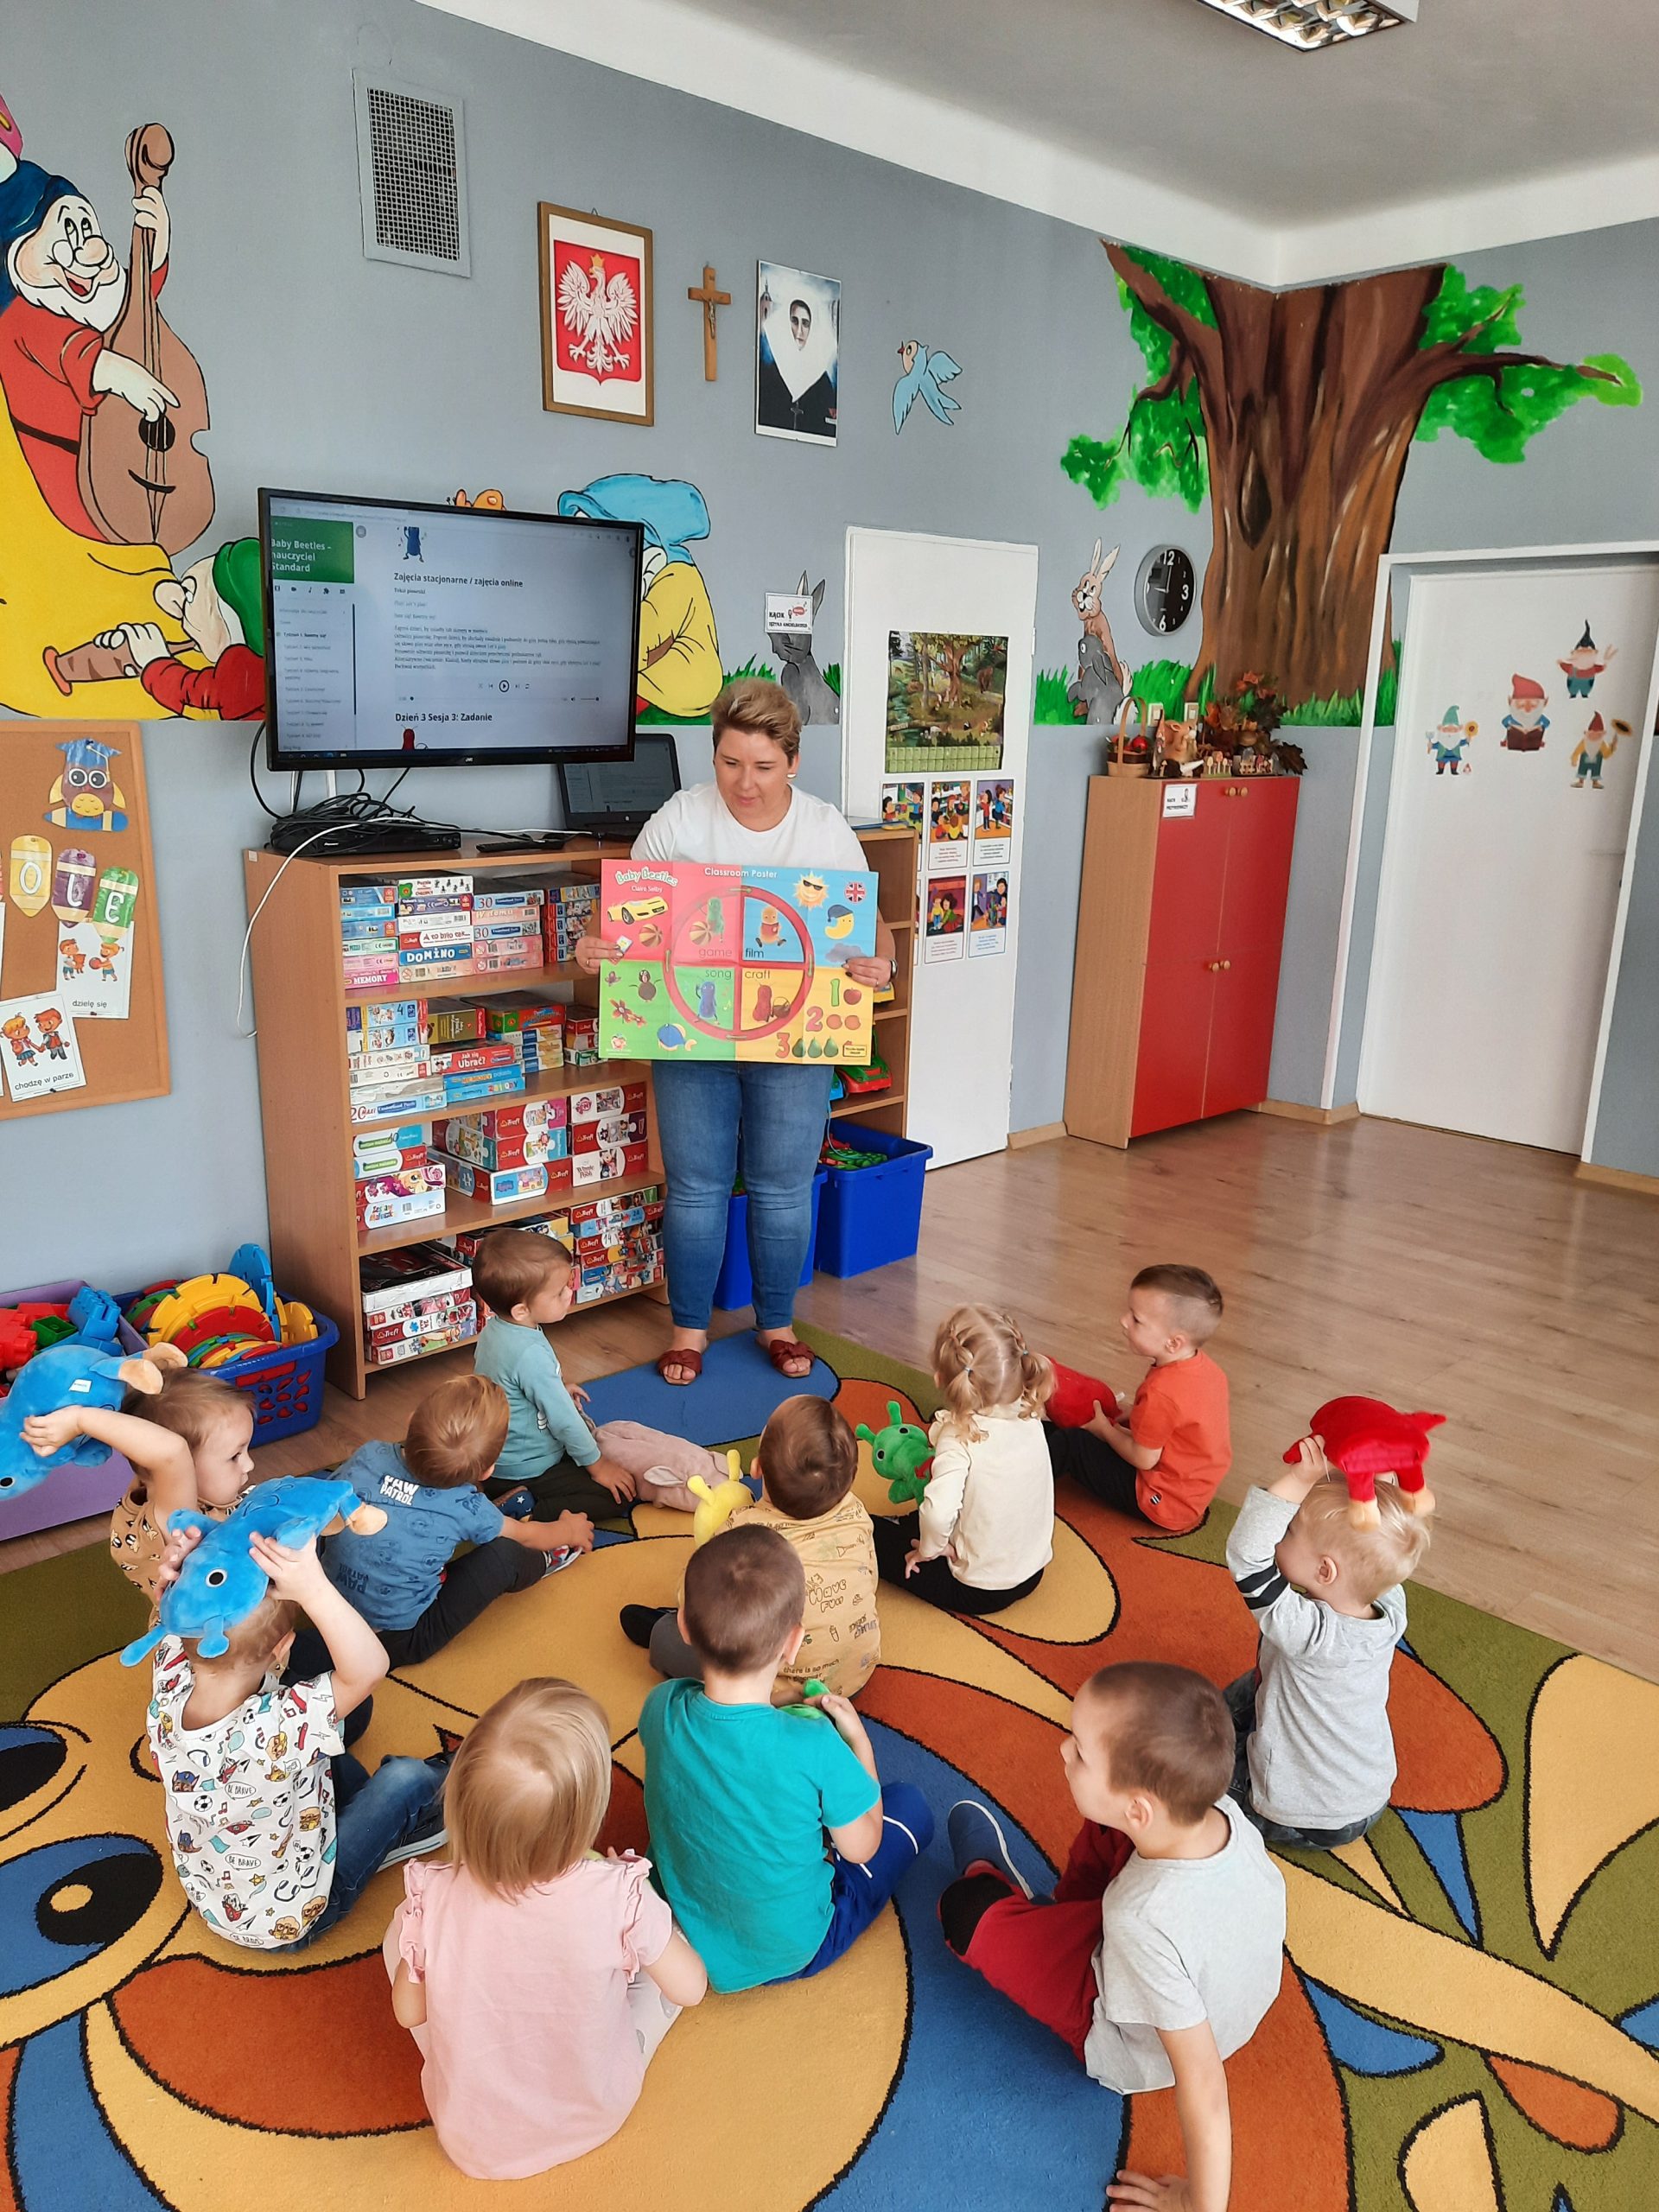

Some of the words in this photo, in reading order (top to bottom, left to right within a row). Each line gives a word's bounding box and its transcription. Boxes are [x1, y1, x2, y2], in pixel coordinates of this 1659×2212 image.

[271, 538, 292, 551] Baby
[294, 540, 326, 550] Beetles
[271, 552, 316, 562] nauczyciel
[1163, 550, 1175, 566] 12
[271, 562, 311, 572] Standard
[394, 572, 422, 583] Zajęcia
[423, 574, 468, 584] stacjonarne
[474, 577, 499, 588] zajęcia
[500, 579, 524, 588] online
[1181, 584, 1189, 601] 3
[1160, 614, 1166, 632] 6
[395, 712, 419, 721] Dzień
[421, 713, 427, 721] 3
[428, 713, 450, 723] Sesja
[451, 713, 459, 721] 3:
[461, 713, 493, 721] Zadanie
[614, 869, 642, 886] Baby
[641, 867, 679, 887] Beetles
[704, 868, 749, 877] Classroom
[751, 869, 778, 879] Poster
[478, 897, 493, 909] 30
[474, 927, 489, 939] 30
[699, 948, 733, 958] game
[745, 948, 765, 958] film
[353, 974, 388, 985] MEMORY
[705, 969, 732, 980] song
[744, 969, 771, 979] craft
[830, 978, 840, 1007] 1
[73, 1000, 94, 1008] dzielę
[96, 1000, 107, 1009] się
[805, 1006, 823, 1032] 2
[775, 1032, 791, 1058] 3
[458, 1056, 486, 1069] Ubrać?
[15, 1077, 42, 1091] chodzę
[52, 1071, 74, 1084] parze
[384, 1328, 399, 1338] Trefl
[384, 1475, 420, 1496] PAW
[379, 1483, 416, 1506] PATROL
[783, 1666, 804, 1675] there
[822, 1659, 840, 1669] much
[236, 1785, 253, 1796] BRAVE
[228, 1855, 238, 1865] BE
[238, 1857, 258, 1868] BRAVE
